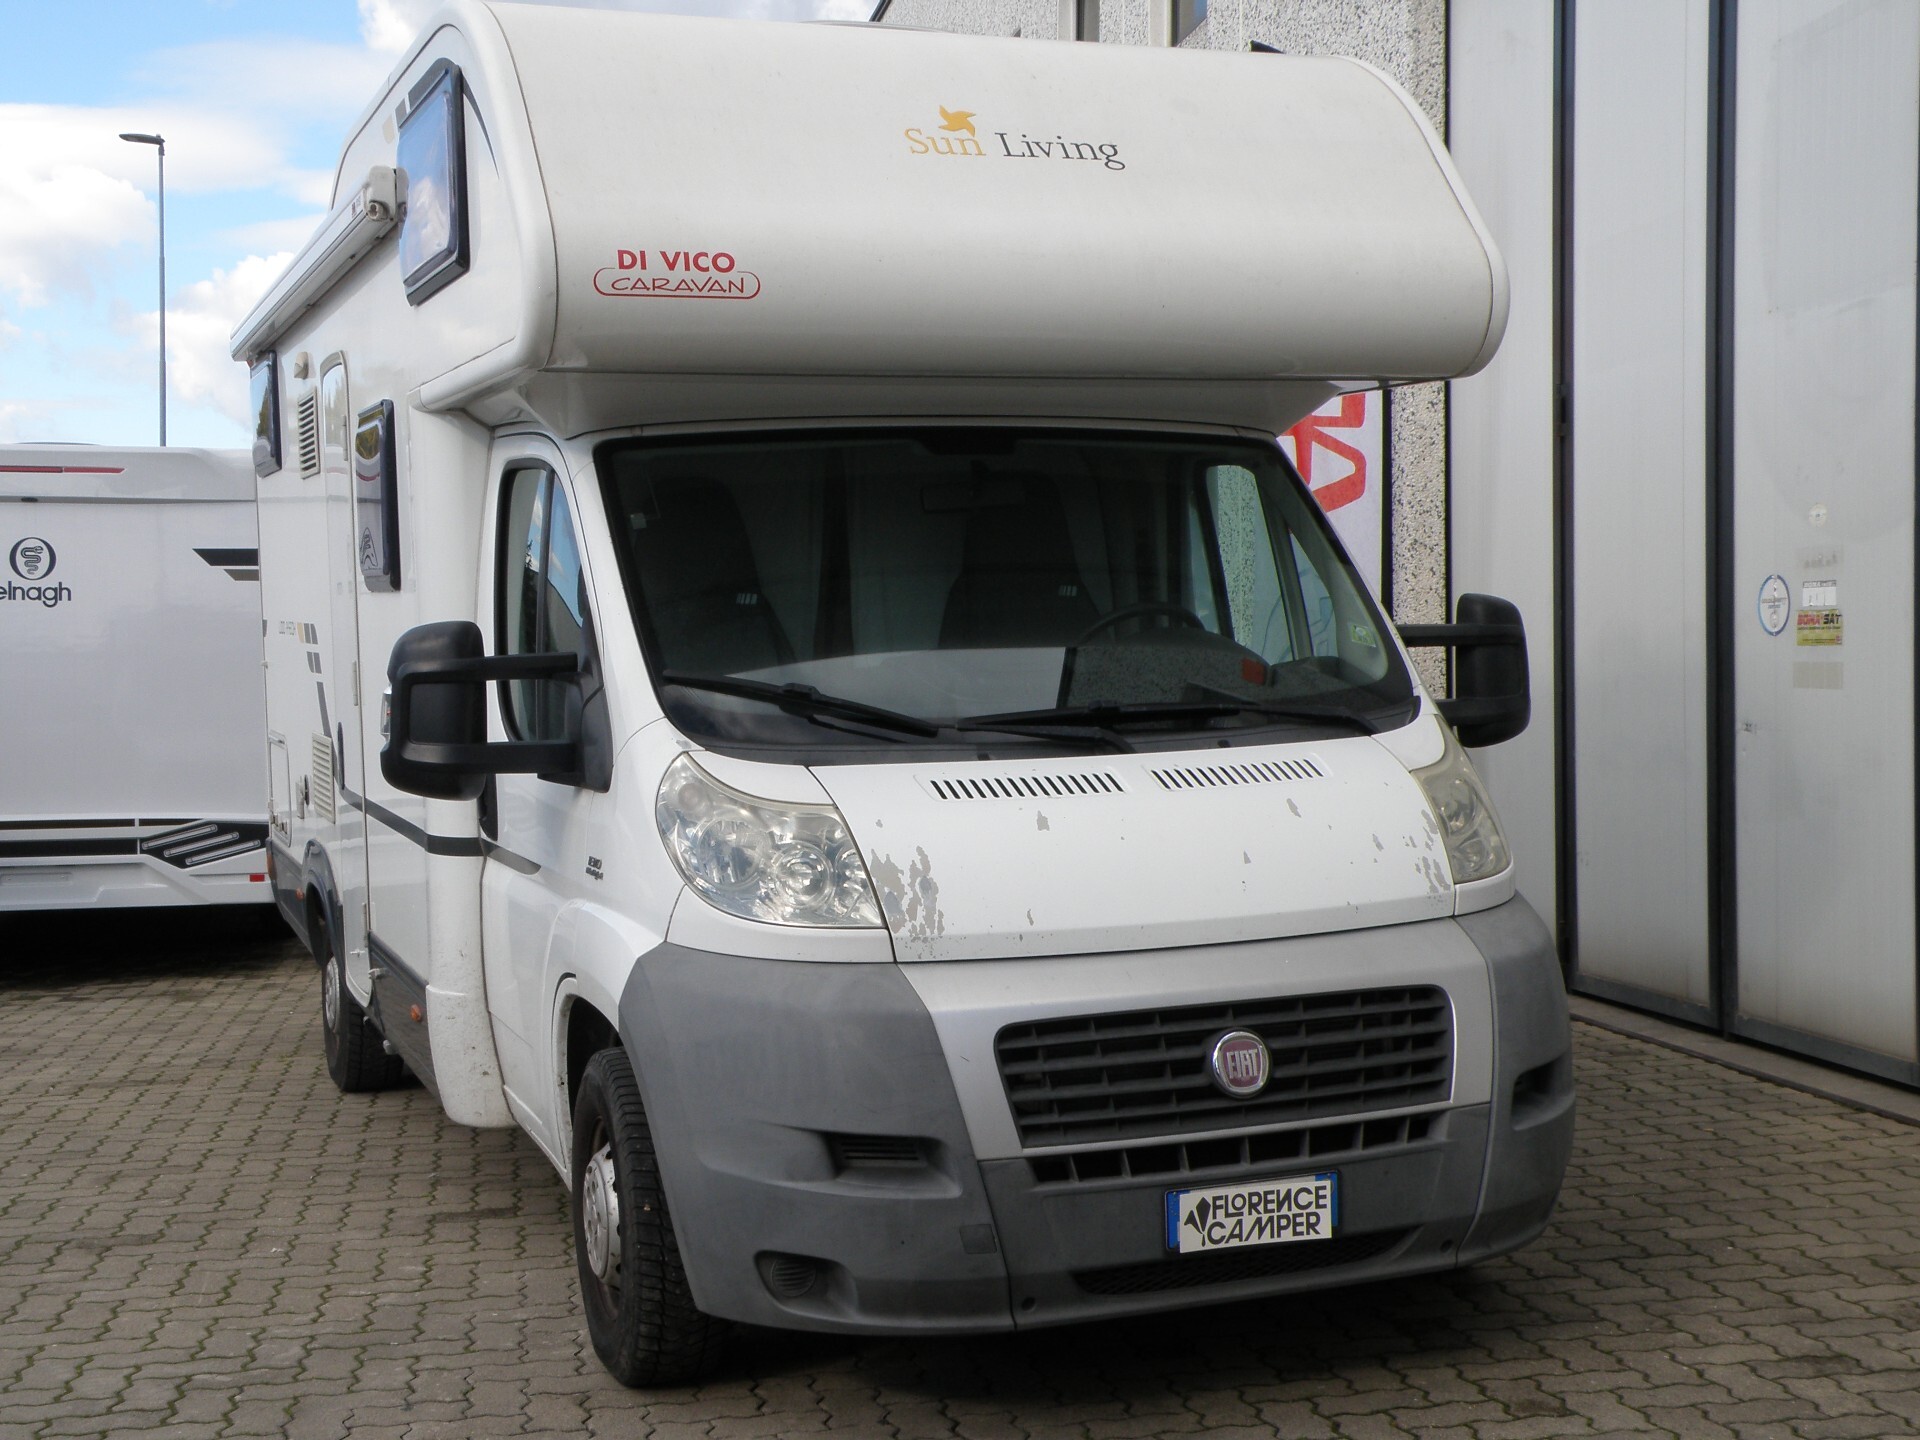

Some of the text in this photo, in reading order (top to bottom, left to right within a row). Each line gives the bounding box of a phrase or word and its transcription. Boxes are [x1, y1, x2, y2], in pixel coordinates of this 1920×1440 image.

[904, 127, 1126, 171] Sun Living
[617, 249, 736, 273] DI VICO
[611, 276, 745, 293] CARAVAN
[1226, 1049, 1258, 1079] FIAT
[1211, 1185, 1328, 1220] FLORENCE
[1207, 1211, 1321, 1245] CAMPER
